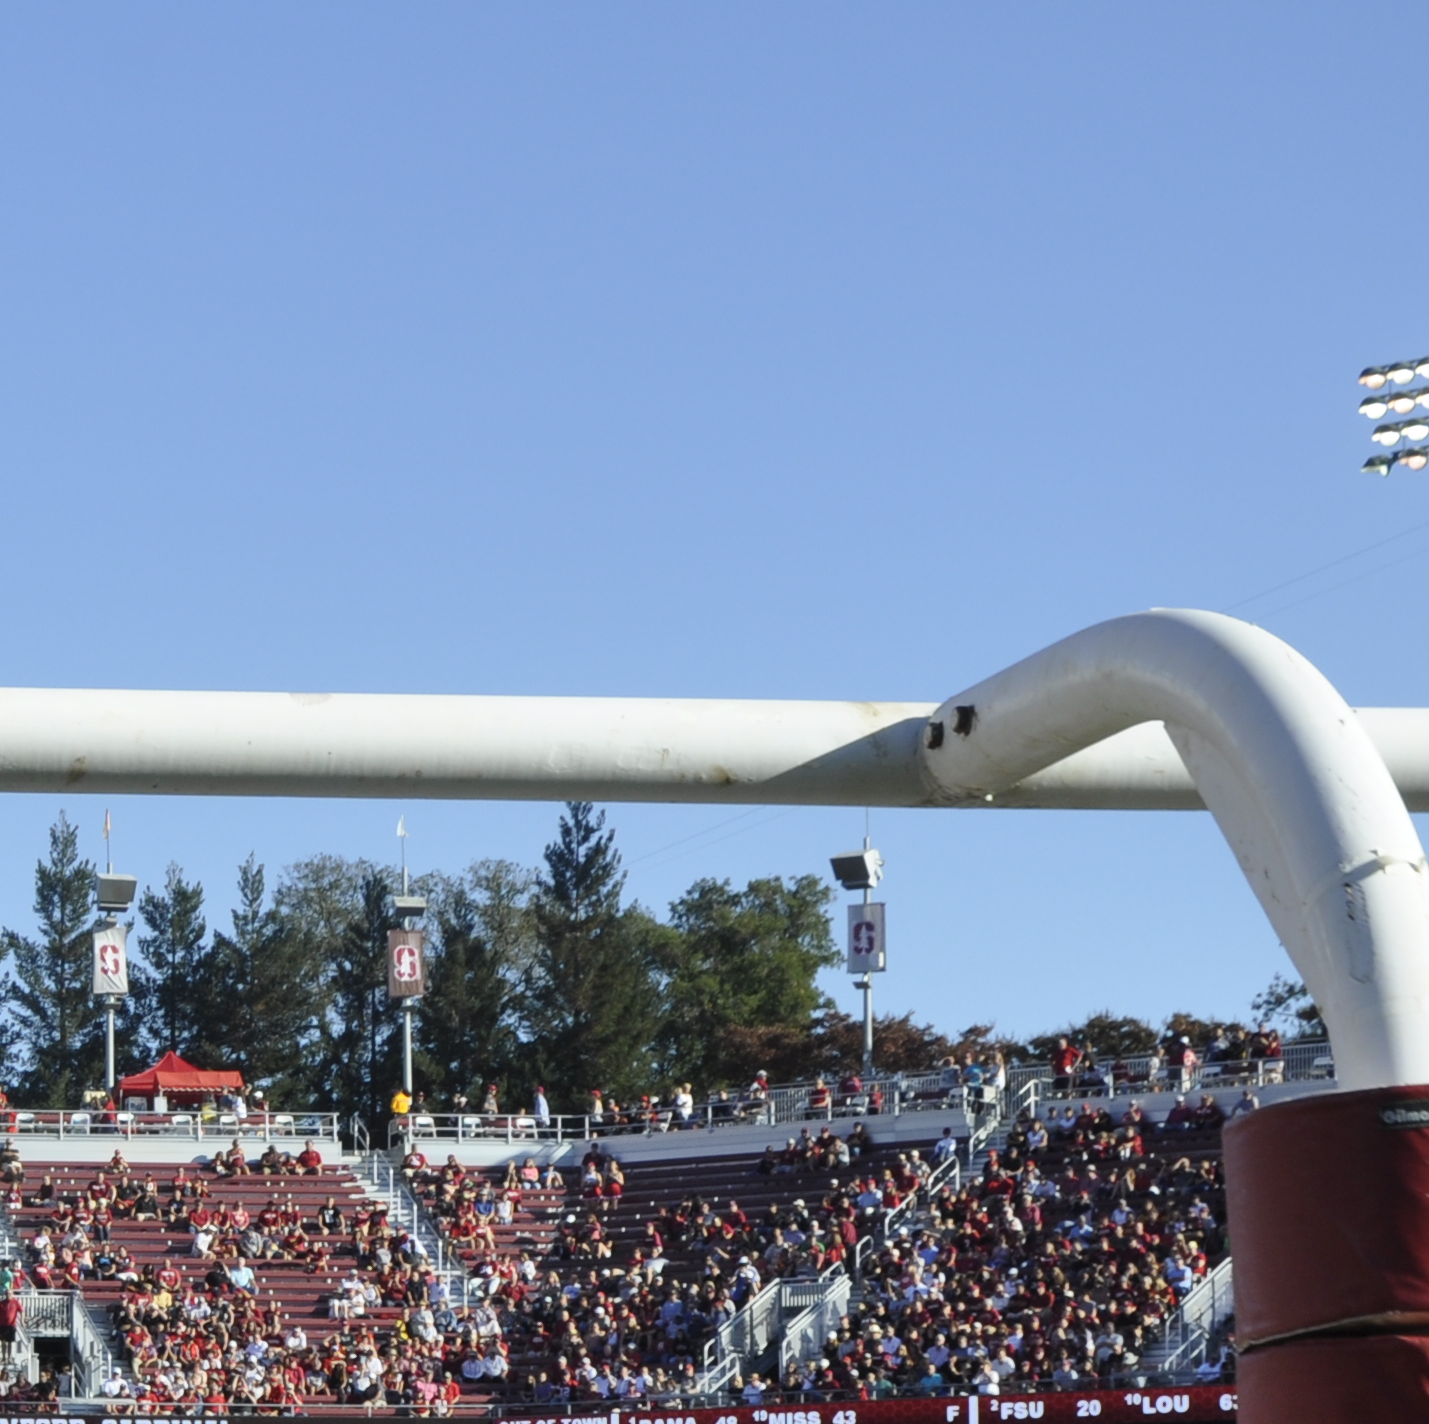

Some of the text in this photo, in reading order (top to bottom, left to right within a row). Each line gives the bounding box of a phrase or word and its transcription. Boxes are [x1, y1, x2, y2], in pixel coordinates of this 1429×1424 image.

[752, 1410, 768, 1422] 19
[946, 1405, 961, 1422] F
[1000, 1400, 1045, 1420] FSU
[1076, 1399, 1102, 1417] 20
[1124, 1393, 1141, 1406] 10
[1141, 1395, 1190, 1415] LOU
